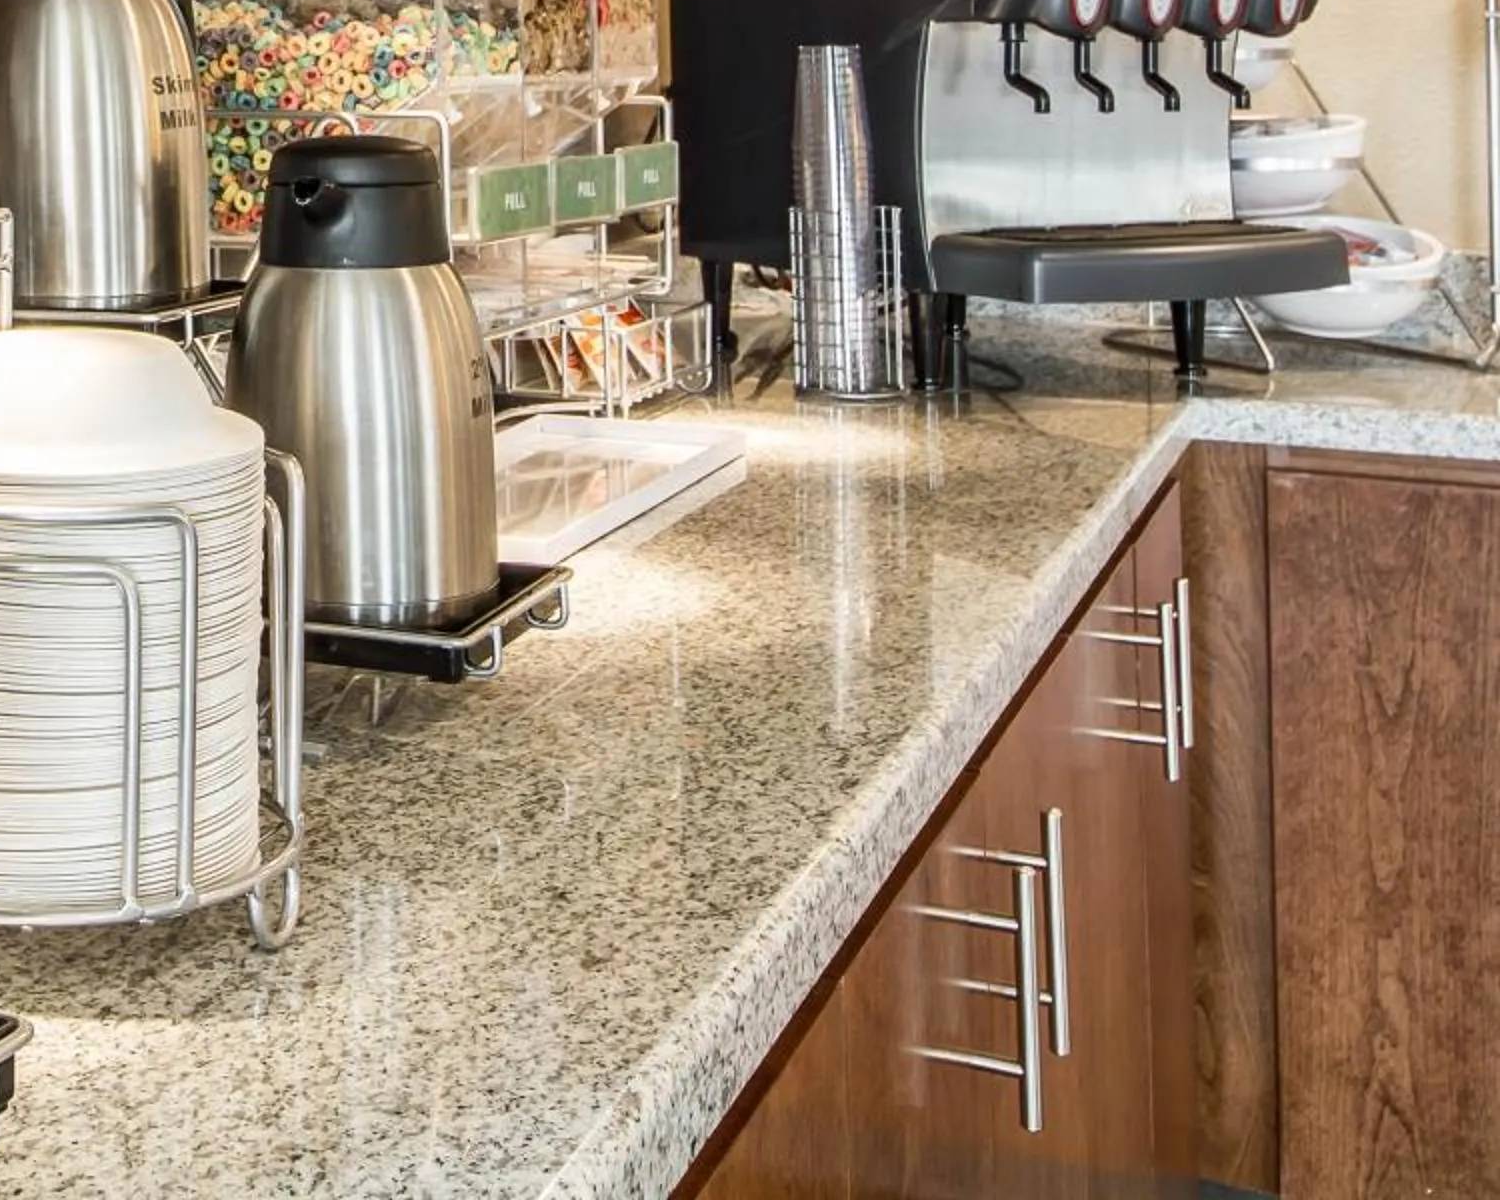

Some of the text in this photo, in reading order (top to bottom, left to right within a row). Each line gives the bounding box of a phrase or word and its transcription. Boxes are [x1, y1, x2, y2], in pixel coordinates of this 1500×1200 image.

[159, 109, 197, 130] Milk
[644, 169, 660, 184] PULL
[577, 180, 597, 198] PULL
[504, 191, 526, 211] PULL
